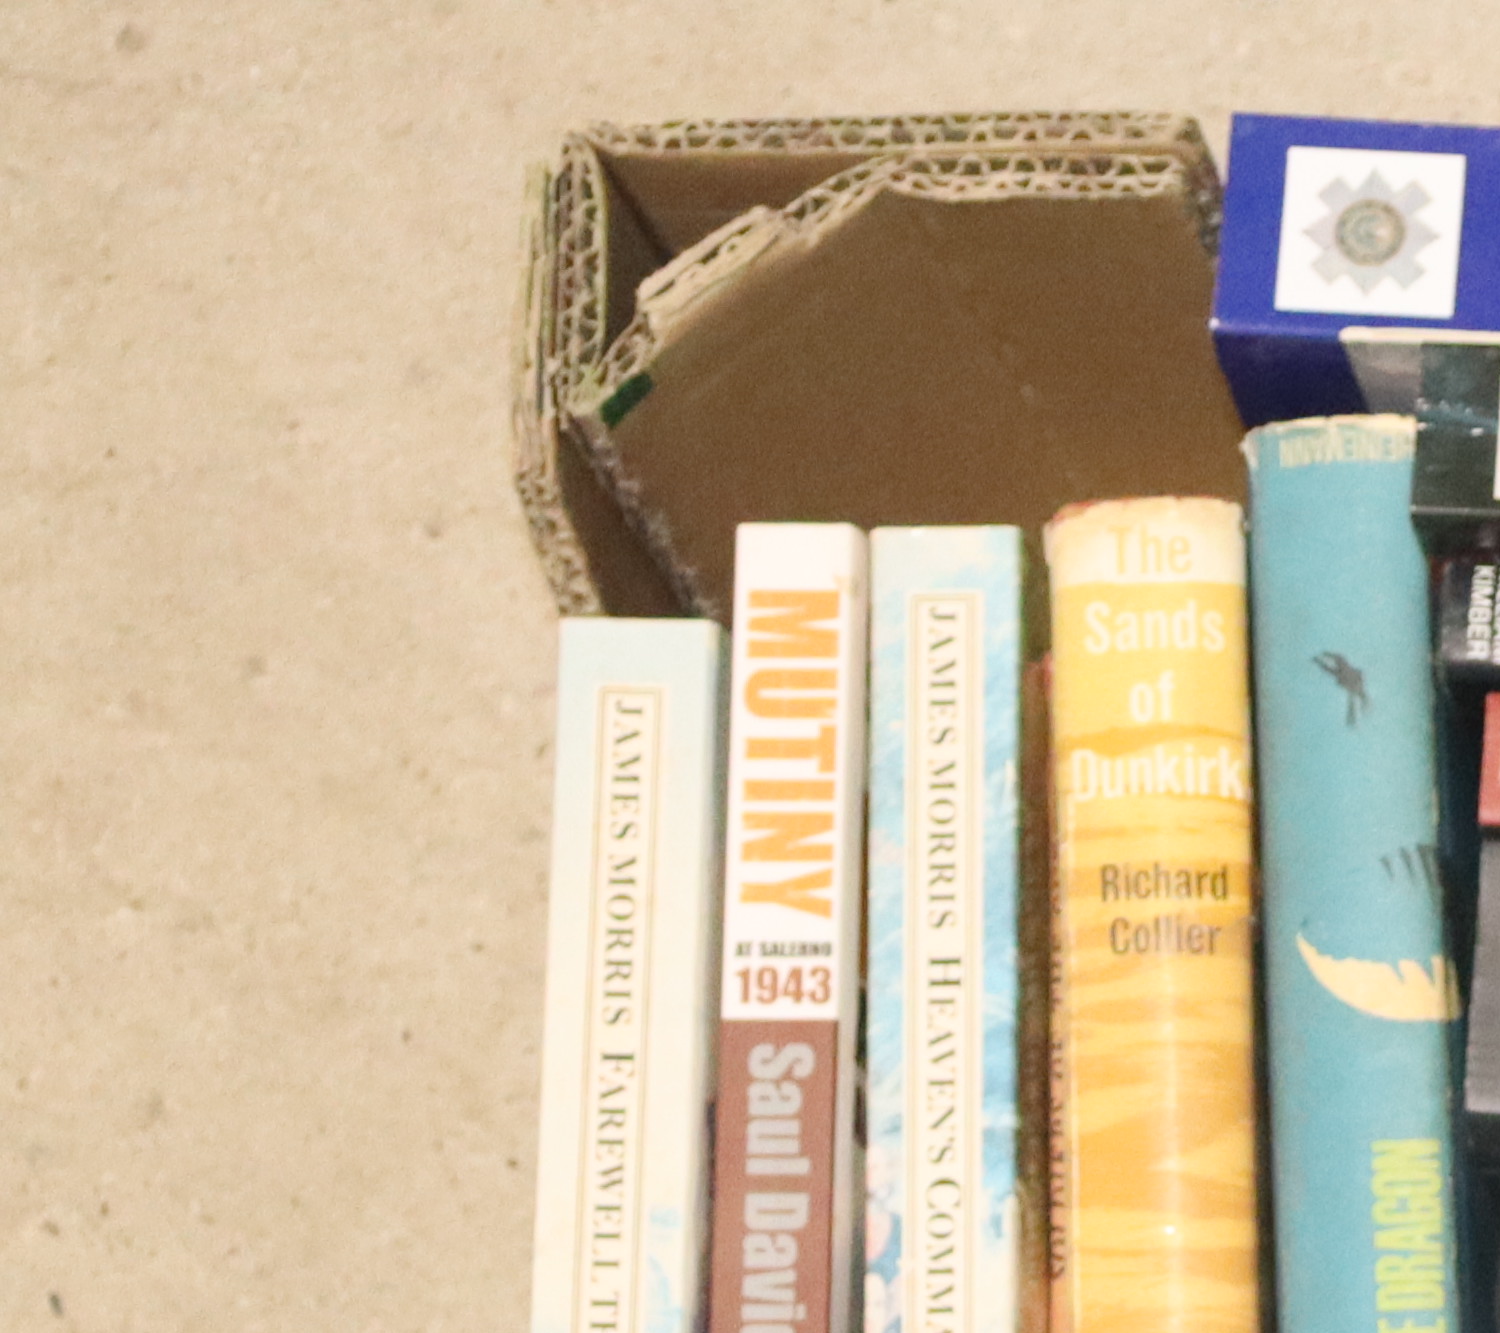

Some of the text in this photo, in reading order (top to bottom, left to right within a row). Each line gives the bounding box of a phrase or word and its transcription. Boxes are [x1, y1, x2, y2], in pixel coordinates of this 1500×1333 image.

[743, 592, 837, 915] MUTINY
[1101, 864, 1229, 900] Richard
[1106, 920, 1223, 955] Collier
[739, 968, 830, 1003] 1943
[748, 1045, 813, 1173] Saul
